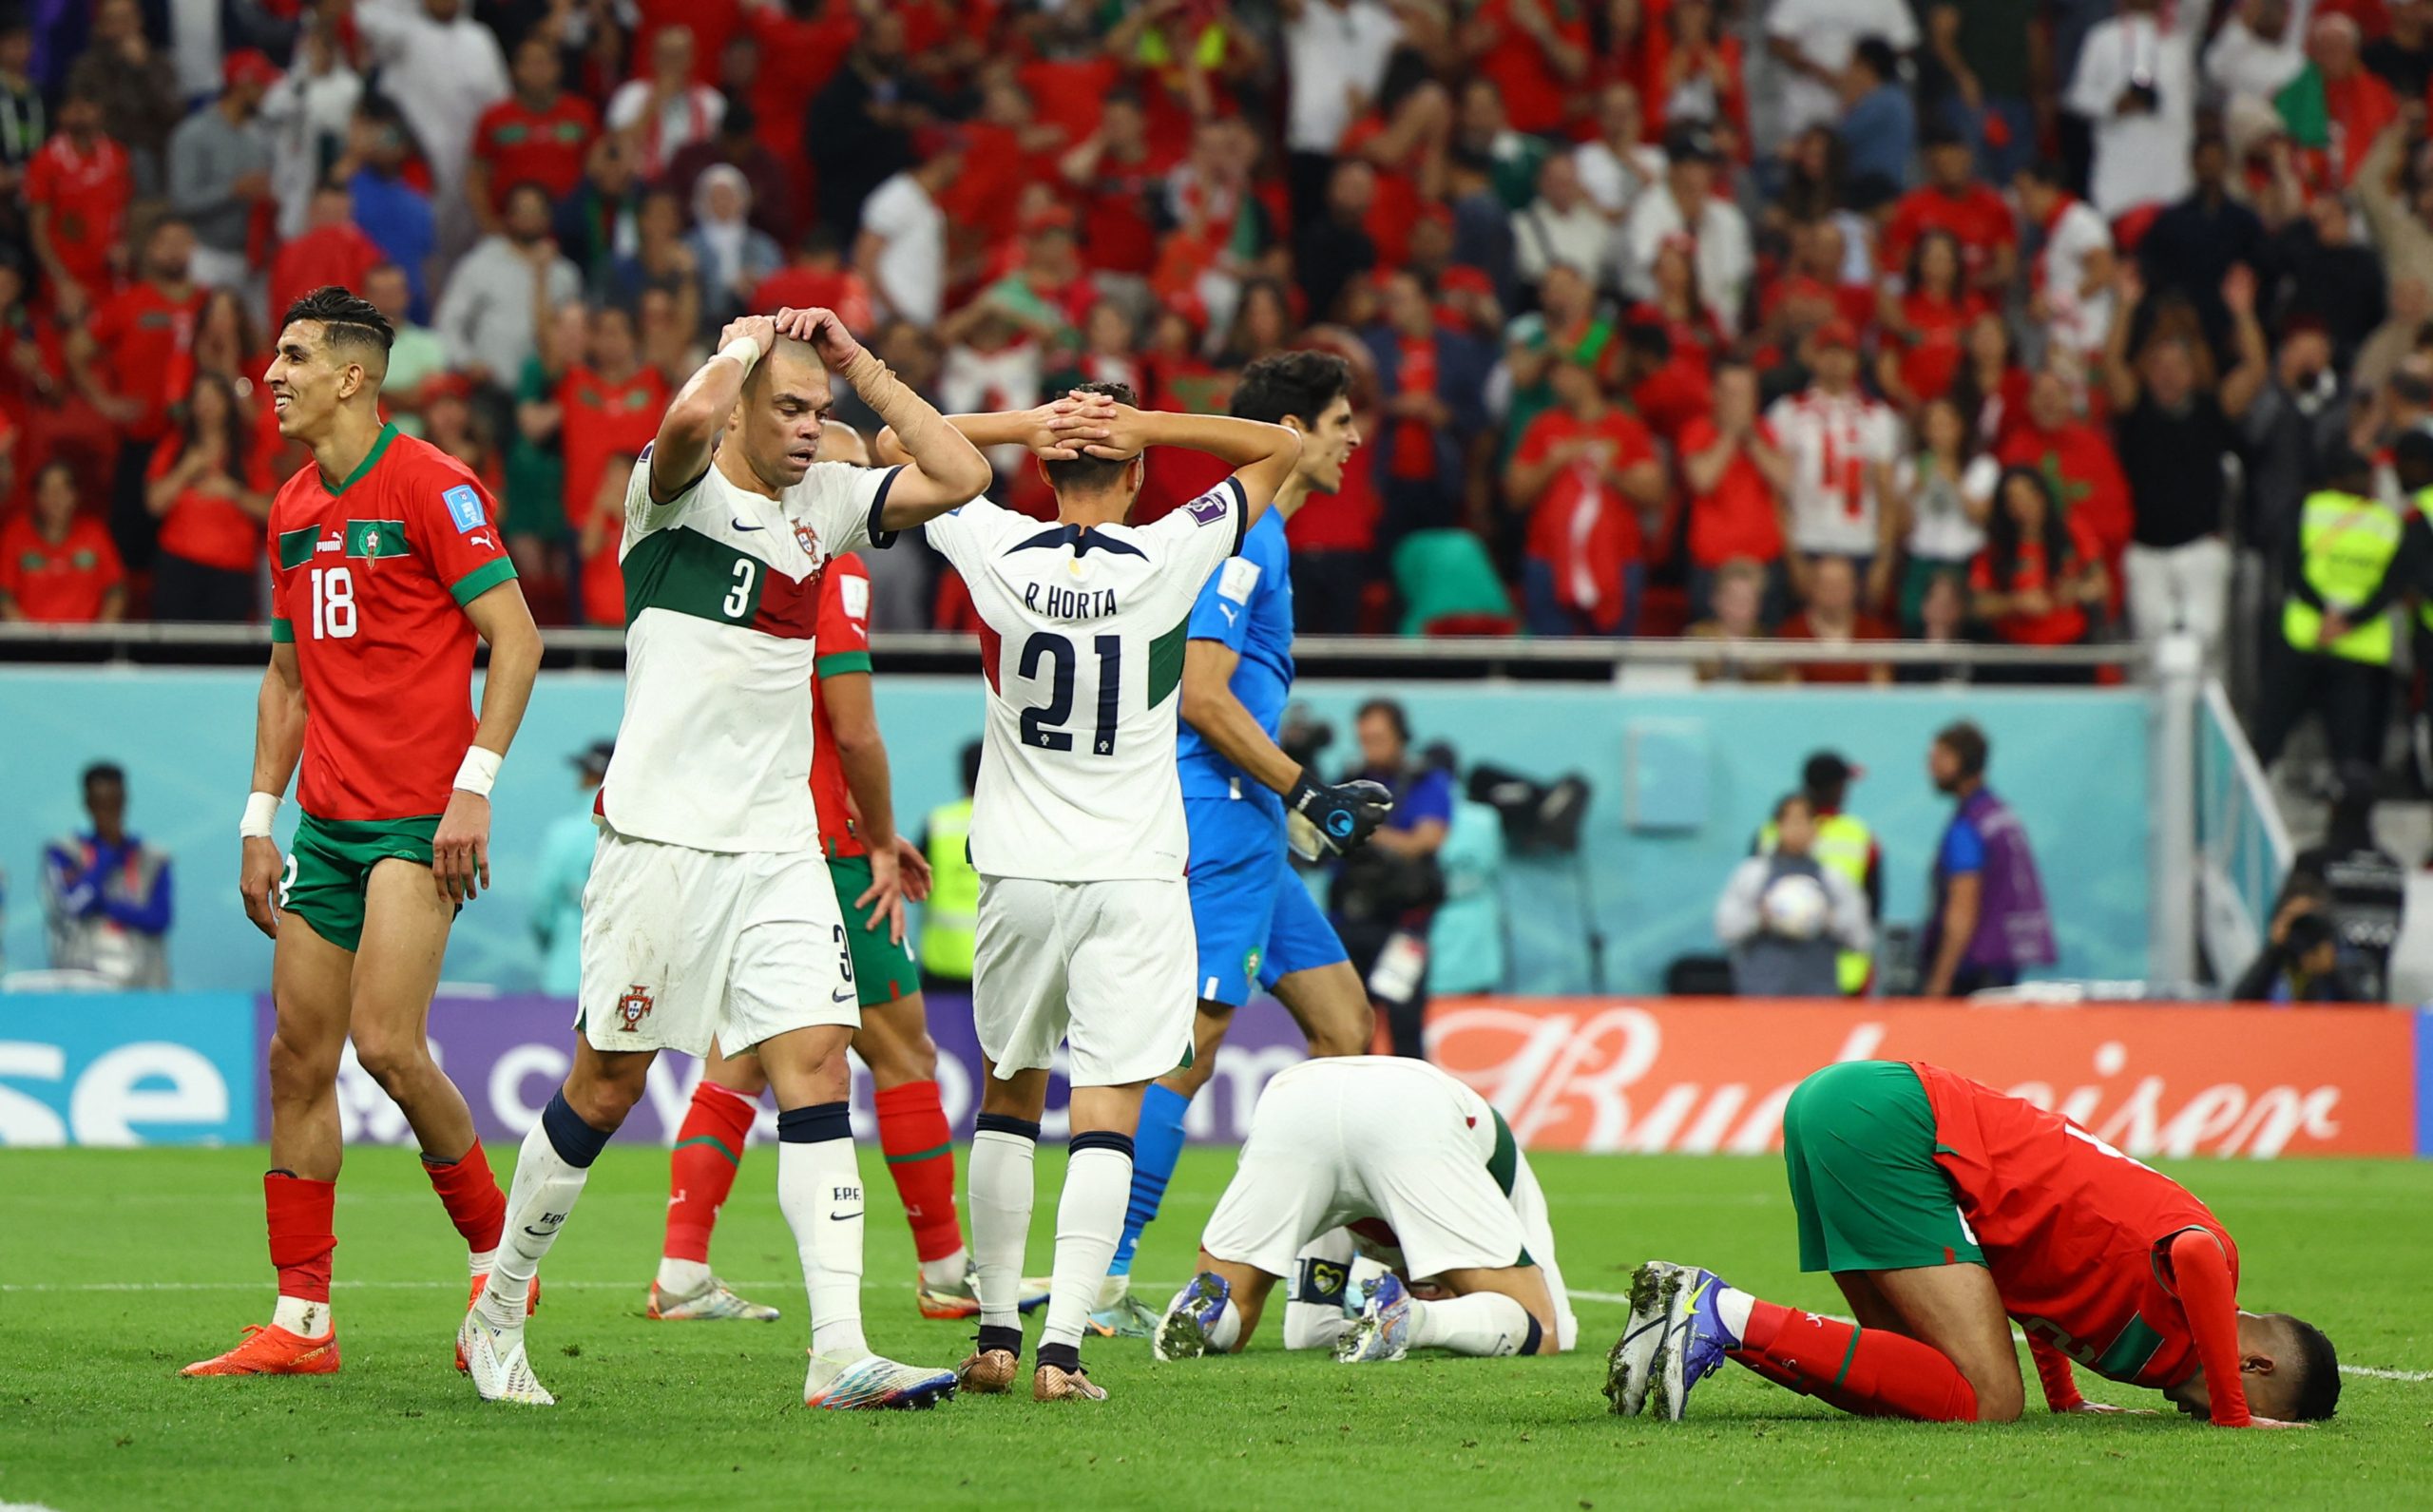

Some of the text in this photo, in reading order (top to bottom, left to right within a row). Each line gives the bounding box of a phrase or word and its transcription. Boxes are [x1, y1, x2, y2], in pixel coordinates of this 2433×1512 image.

[311, 566, 357, 641] 18
[722, 557, 757, 619] 3
[1018, 631, 1121, 756] 21
[833, 923, 853, 983] 3
[1422, 1006, 2342, 1158] Buiser
